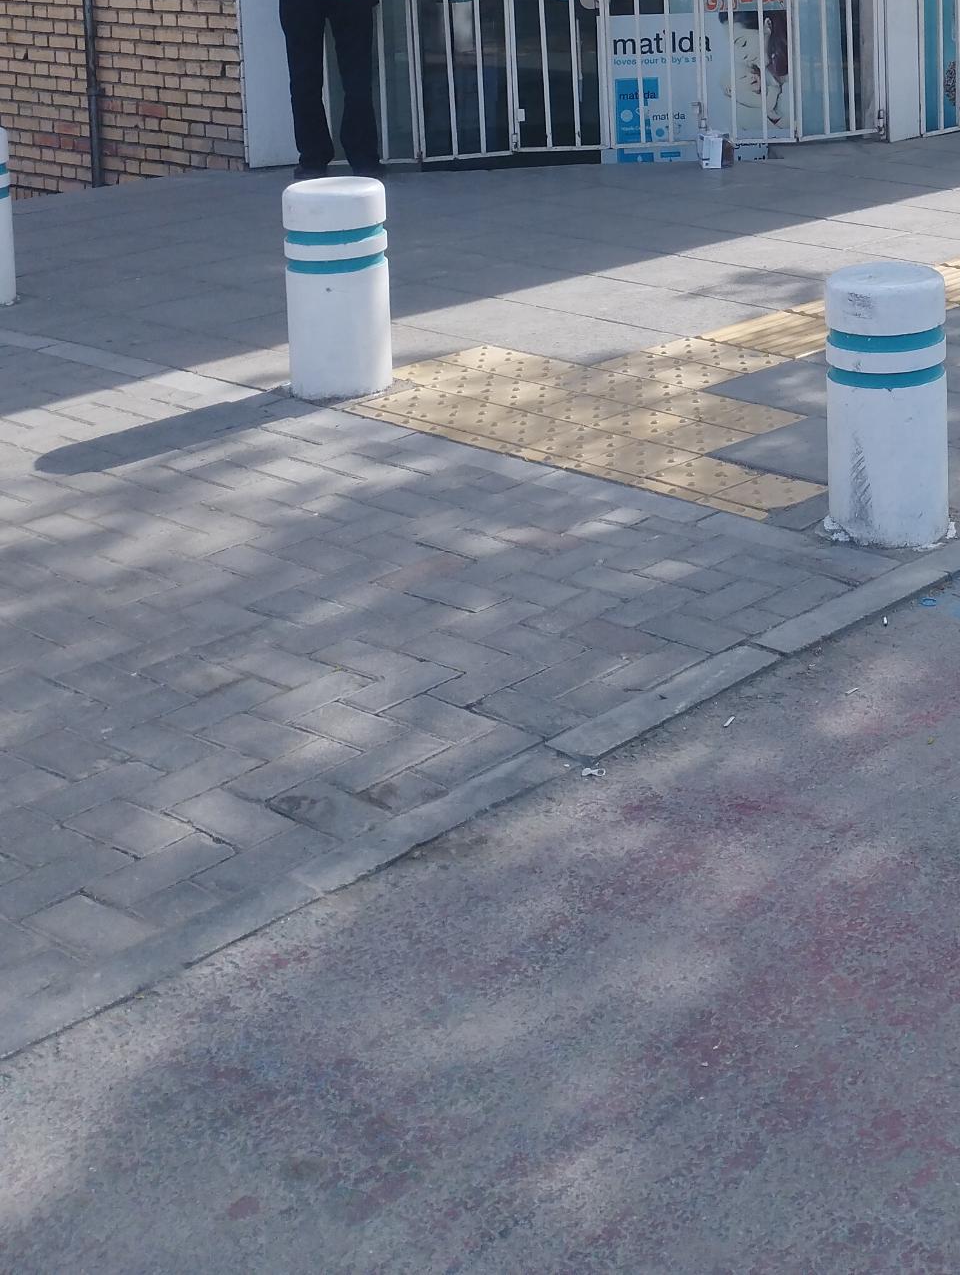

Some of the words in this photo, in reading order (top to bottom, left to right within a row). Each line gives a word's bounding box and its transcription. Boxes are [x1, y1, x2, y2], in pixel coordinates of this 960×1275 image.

[613, 29, 711, 56] matlda
[640, 57, 659, 65] our
[661, 56, 690, 65] bby's
[620, 91, 657, 101] matda
[652, 112, 686, 122] matda
